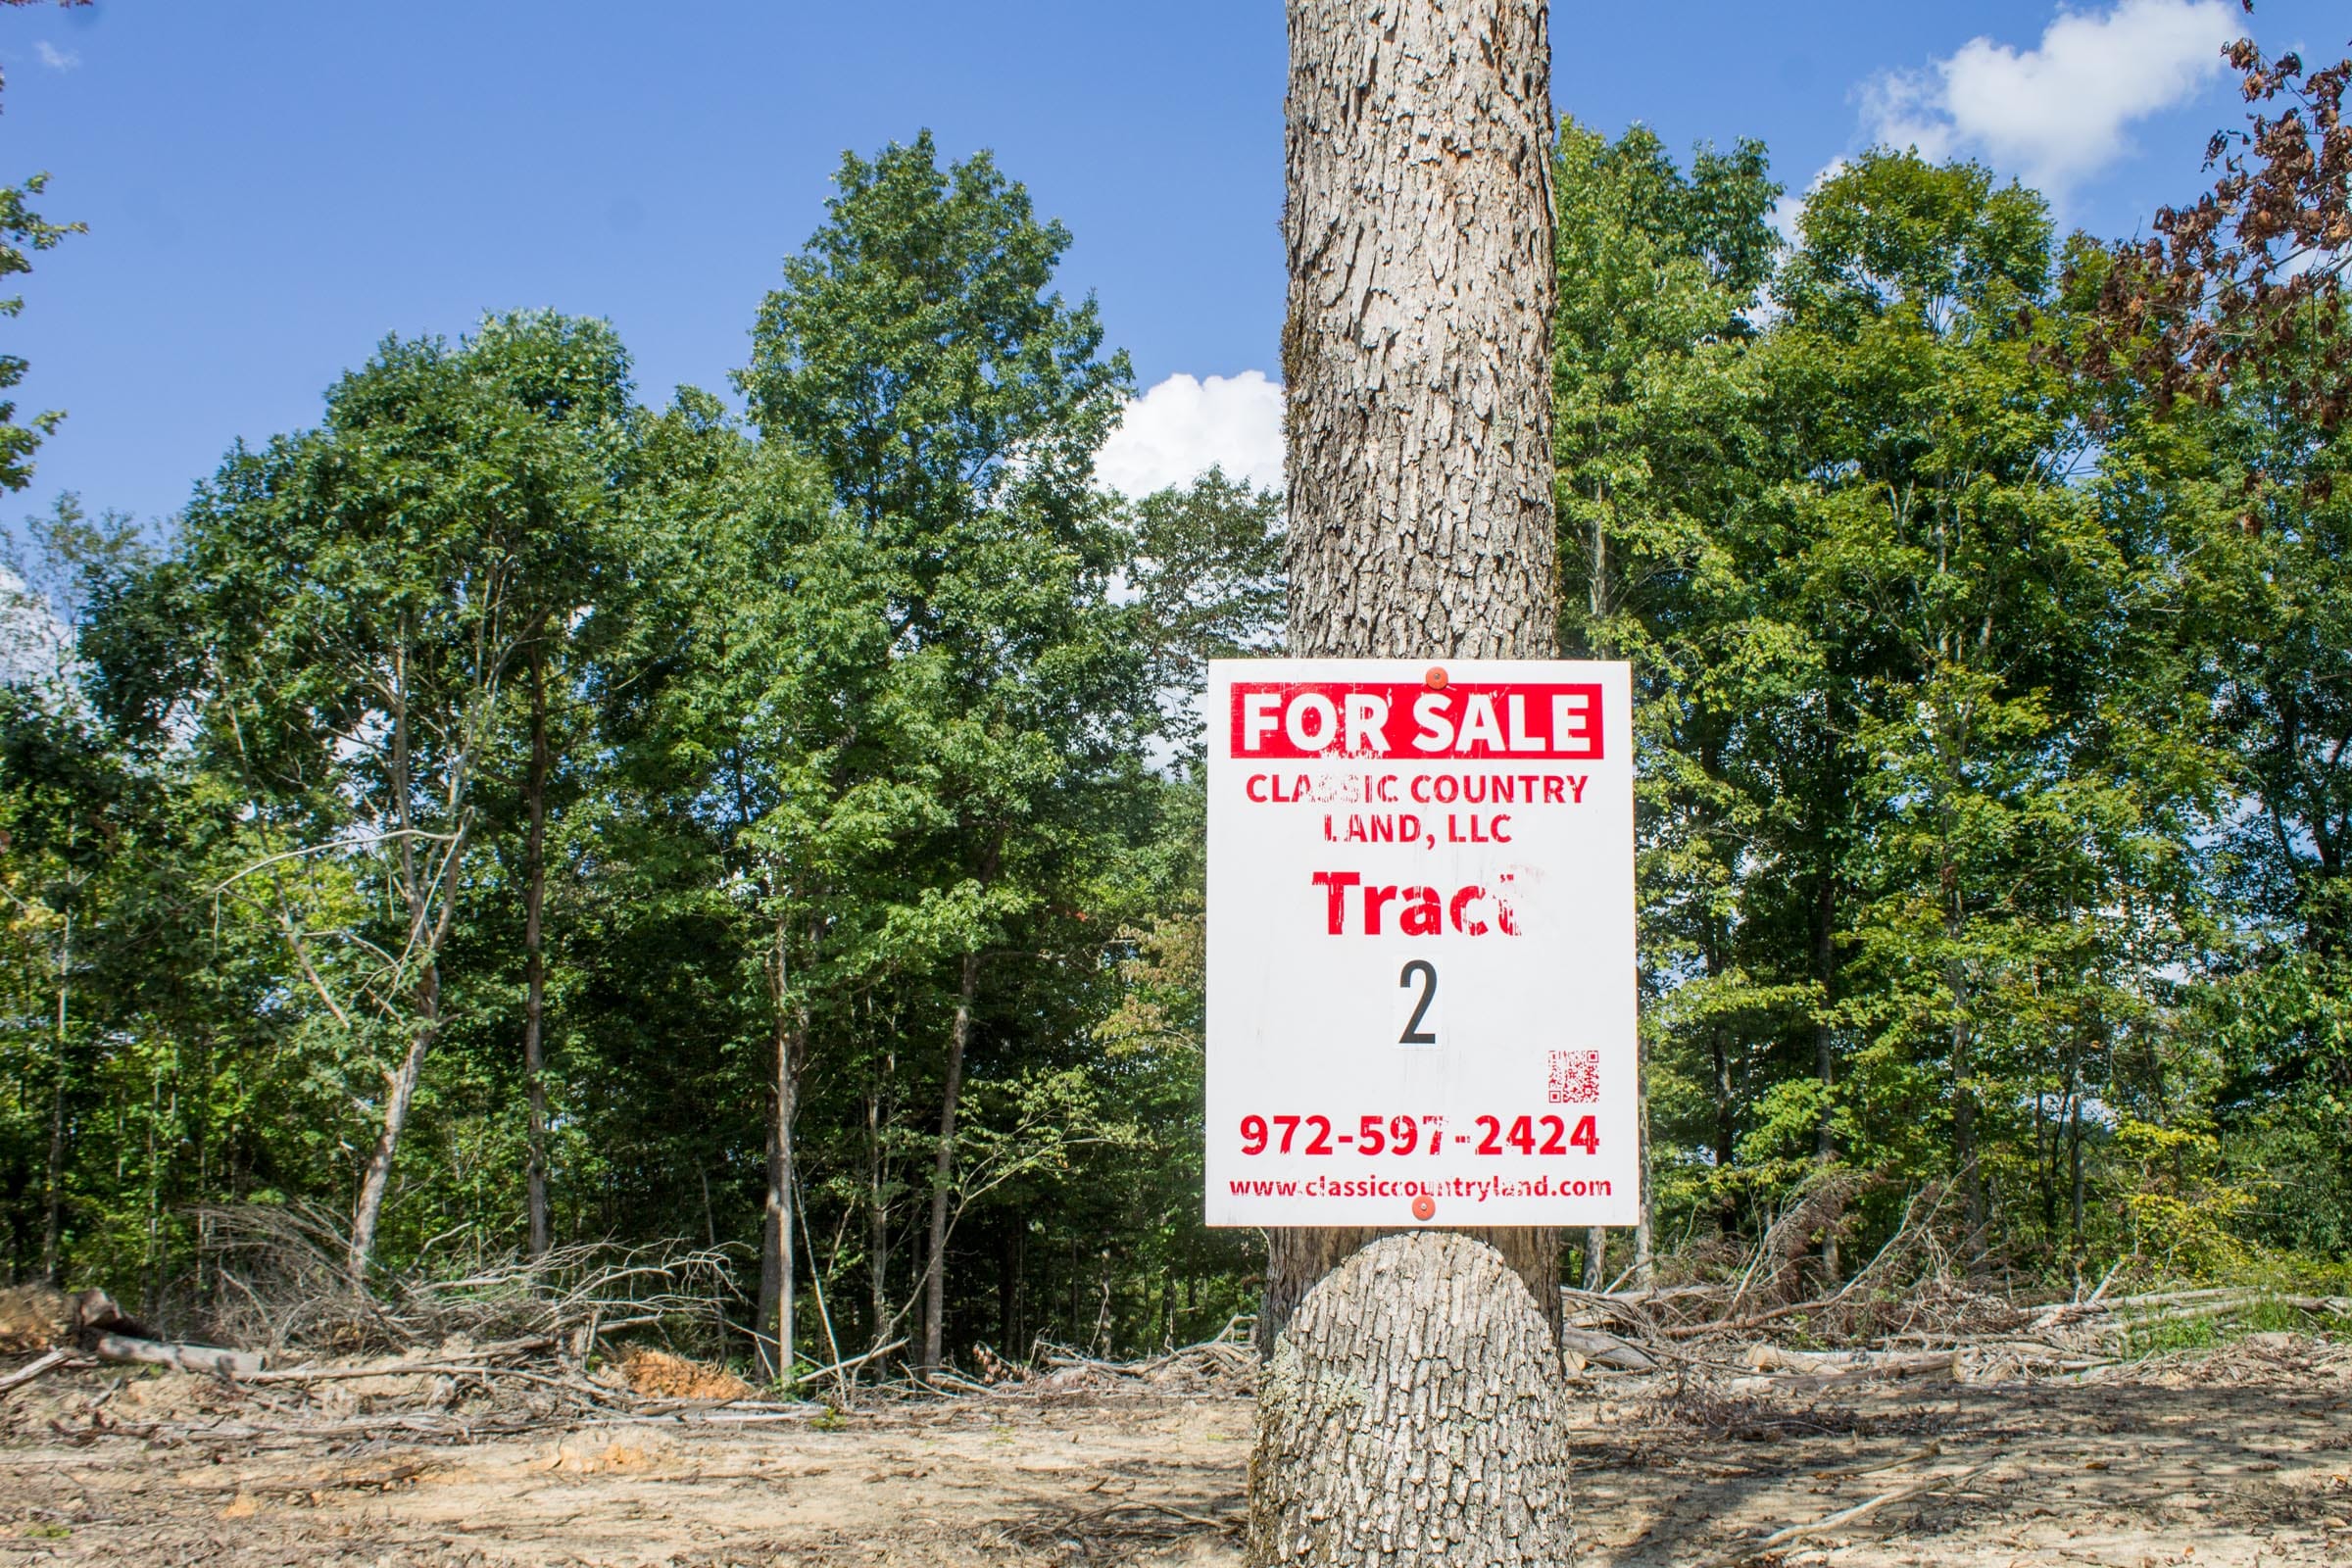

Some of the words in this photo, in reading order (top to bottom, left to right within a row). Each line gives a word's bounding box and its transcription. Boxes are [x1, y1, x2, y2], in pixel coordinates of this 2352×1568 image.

[1243, 693, 1392, 753] FOR
[1411, 694, 1592, 753] SALE
[1409, 774, 1589, 805] COUNTRY
[1324, 813, 1436, 851] LAND,
[1447, 813, 1512, 844] LLC
[1397, 959, 1439, 1046] 2
[1240, 1113, 1600, 1156] 972-597-2424
[1229, 1174, 1613, 1202] wwwclassiccountryland.com
